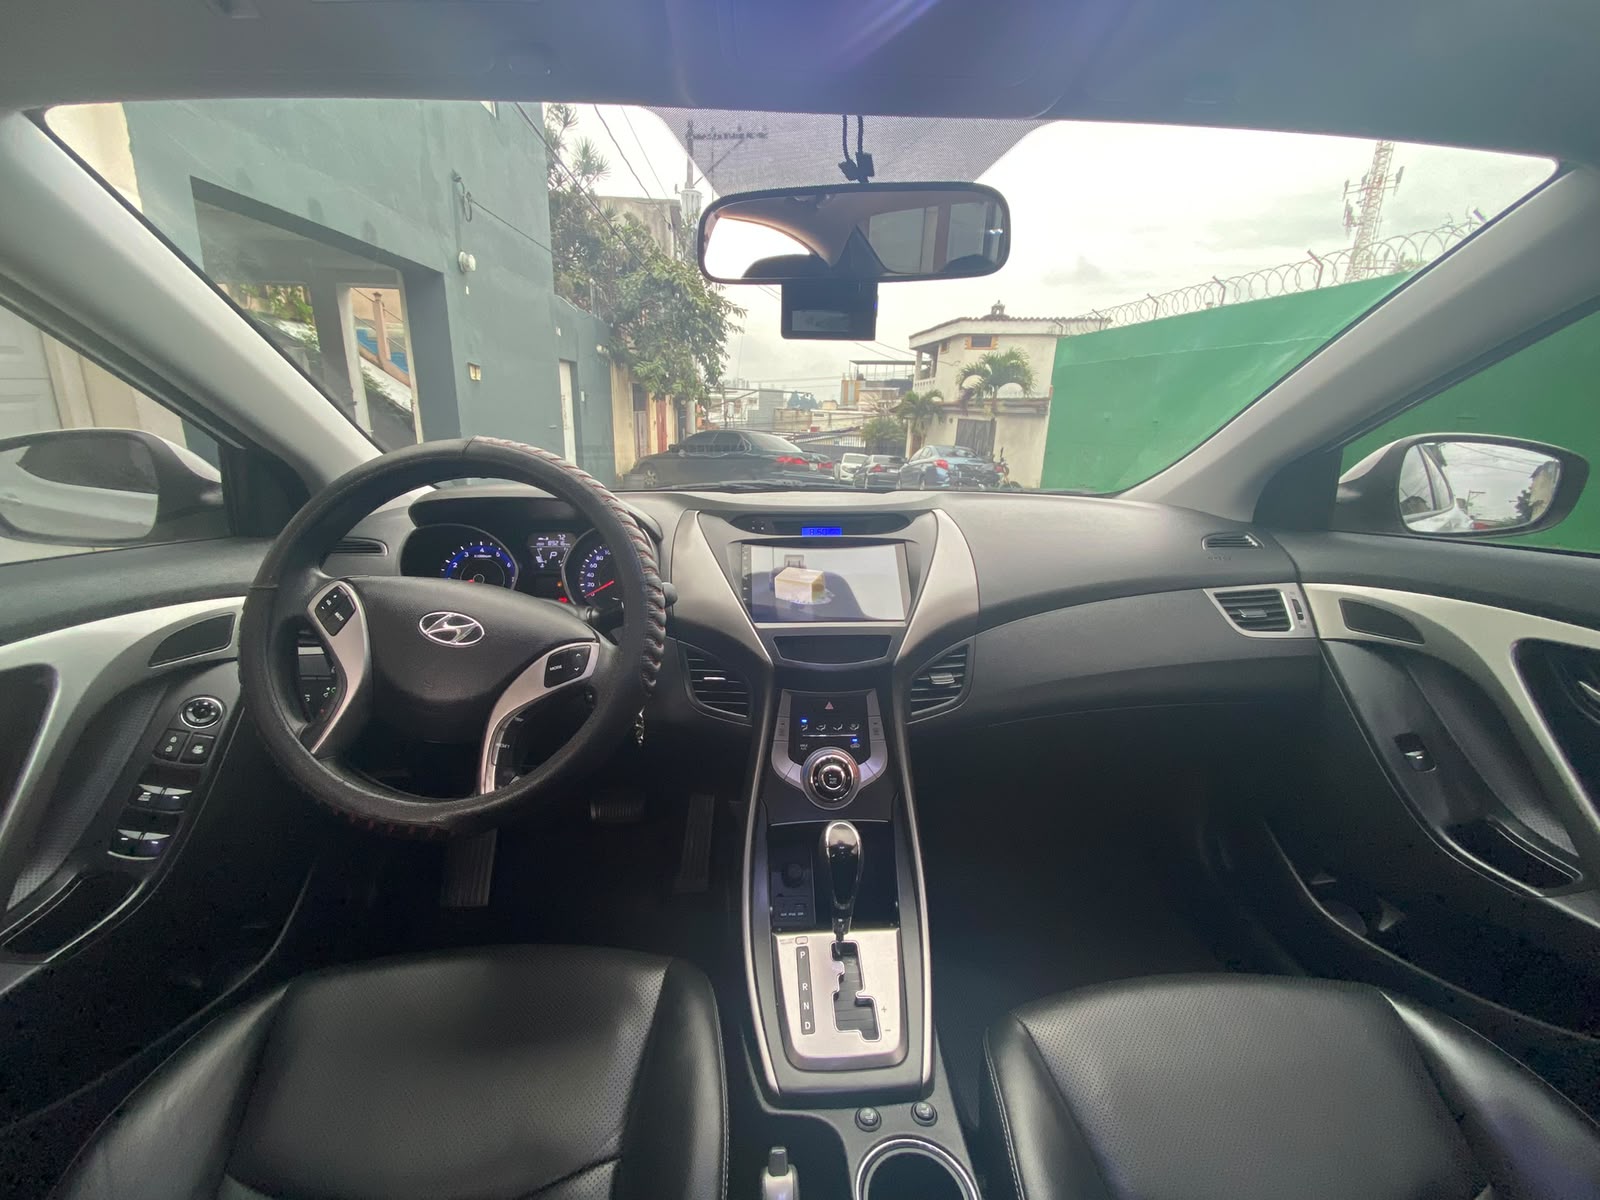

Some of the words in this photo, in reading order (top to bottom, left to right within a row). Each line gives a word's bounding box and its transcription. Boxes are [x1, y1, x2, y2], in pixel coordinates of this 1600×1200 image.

[549, 551, 558, 560] P
[799, 950, 806, 959] P
[802, 982, 809, 991] R
[803, 1002, 810, 1010] N
[804, 1021, 811, 1030] D
